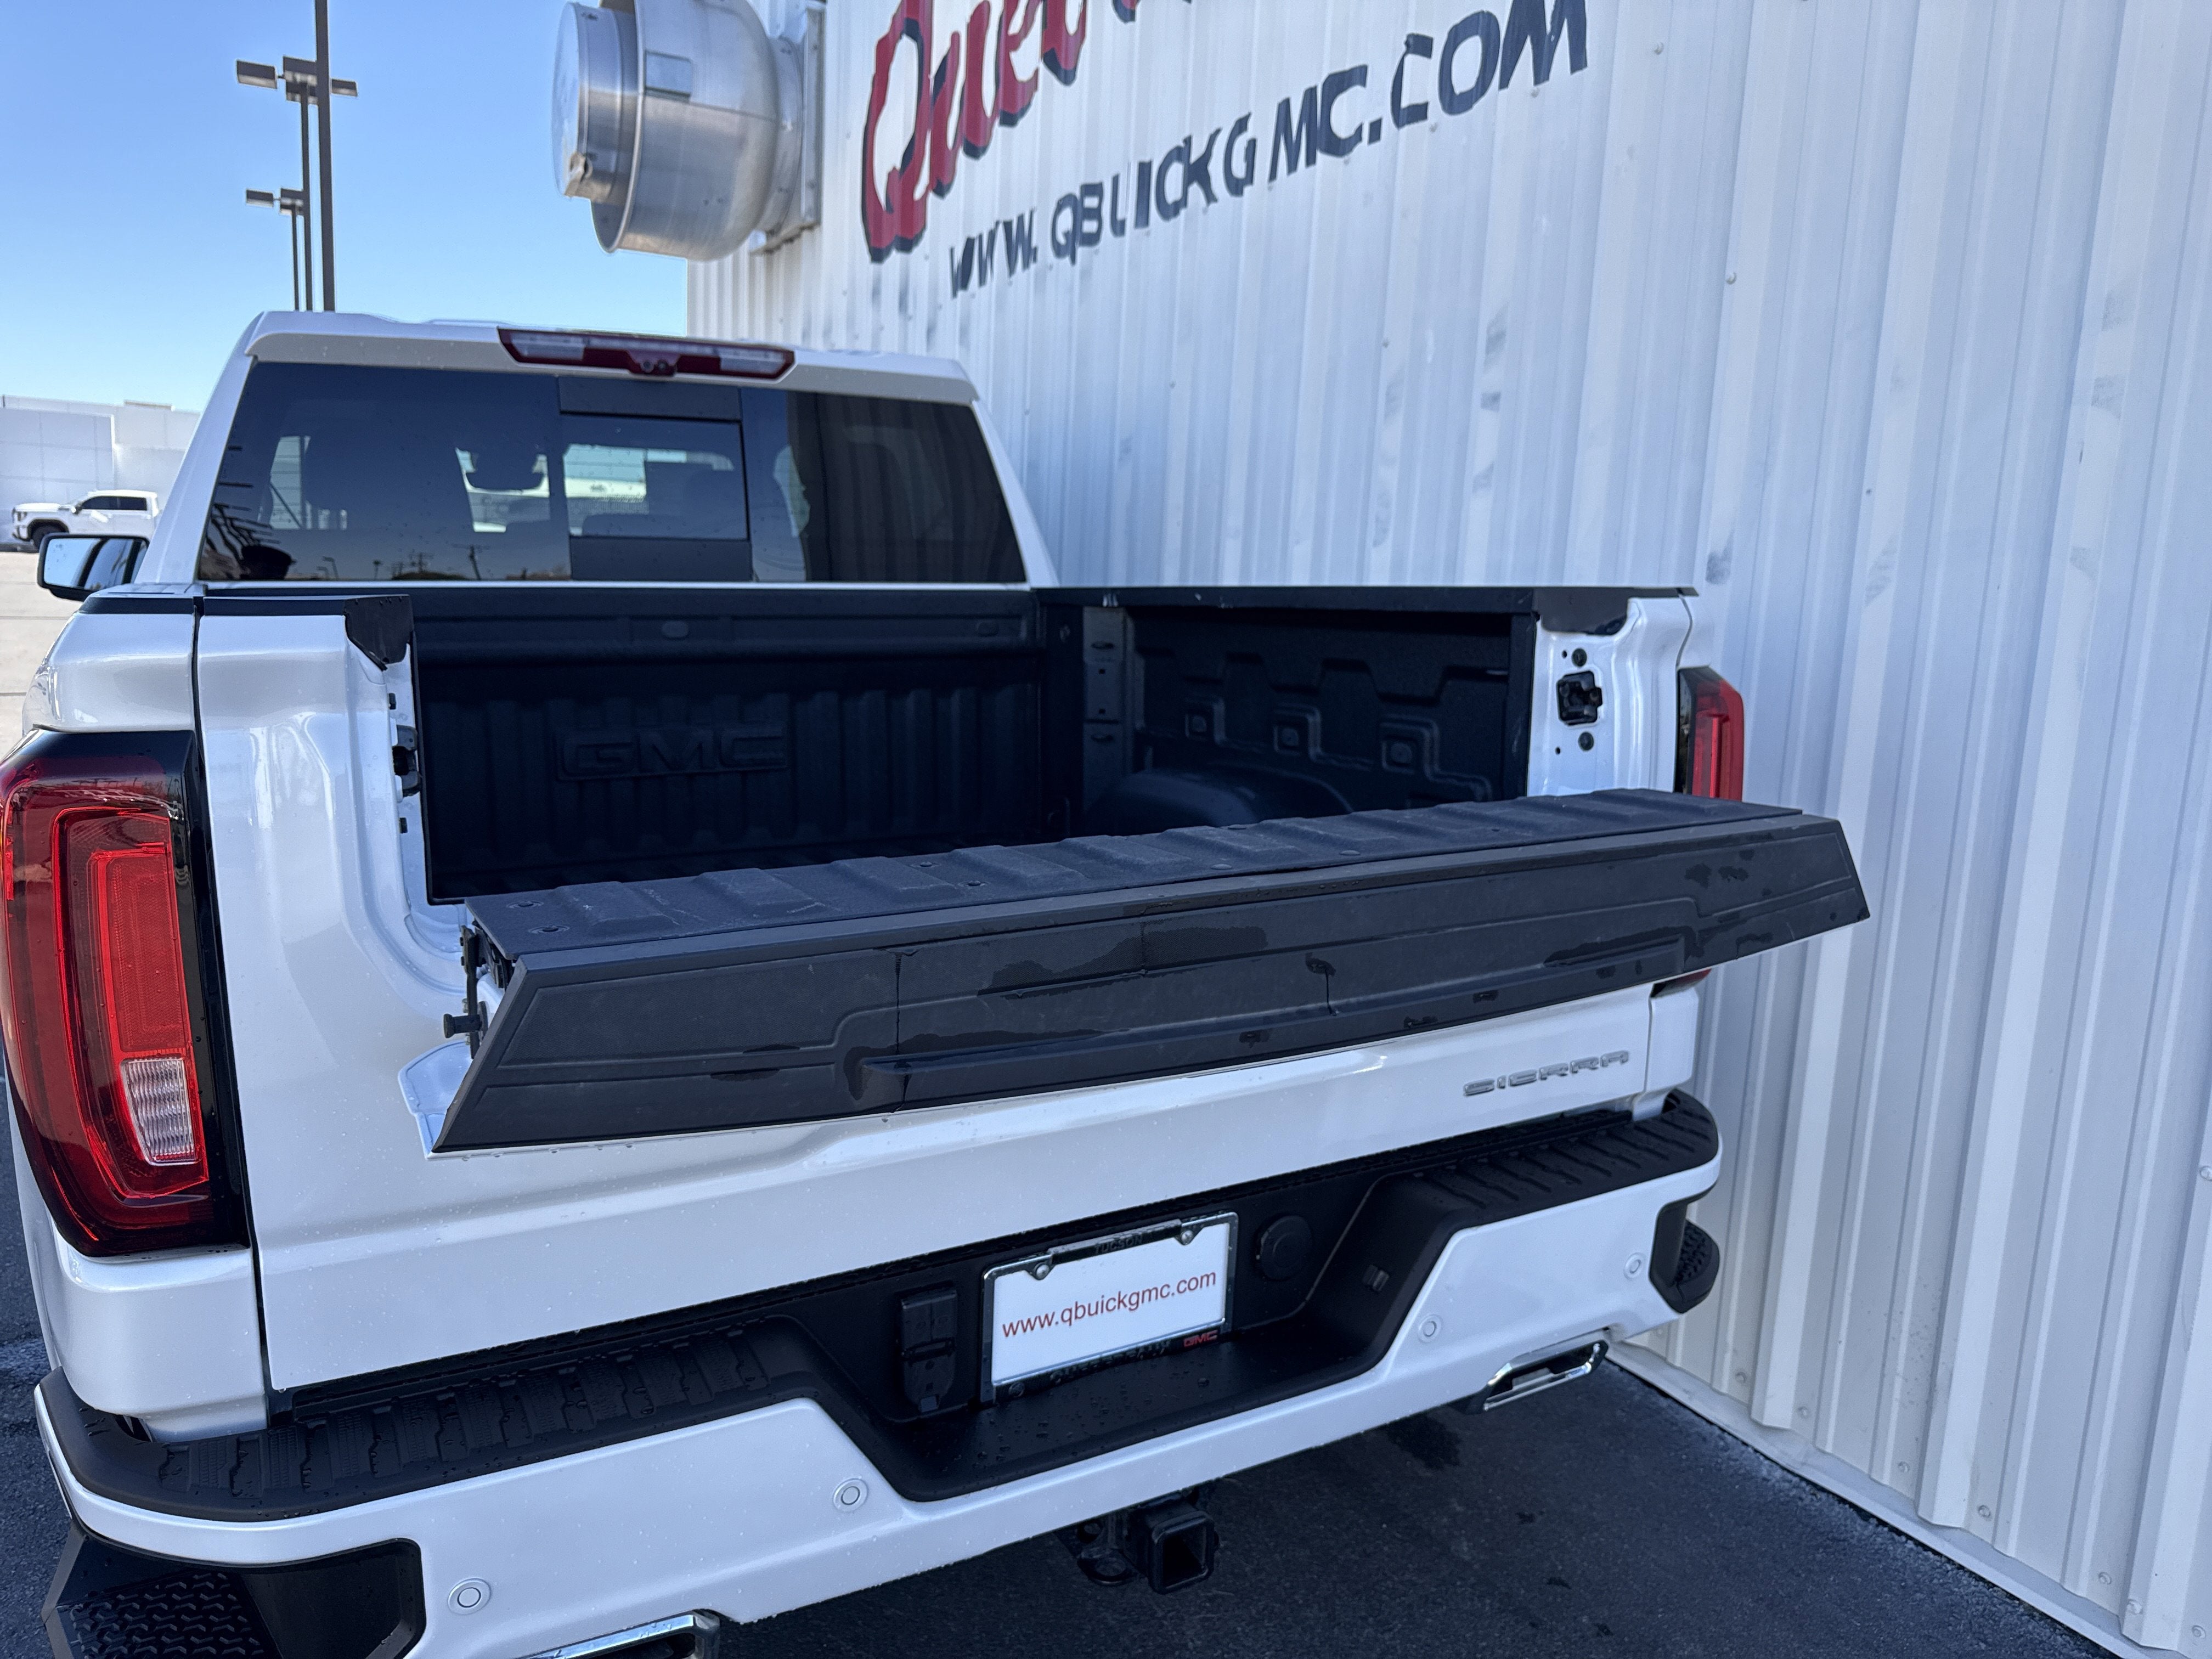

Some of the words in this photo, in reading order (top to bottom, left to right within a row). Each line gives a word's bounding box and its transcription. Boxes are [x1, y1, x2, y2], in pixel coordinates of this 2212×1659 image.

[562, 722, 788, 775] GMC
[1463, 1049, 1629, 1096] SIERRA
[1095, 1234, 1143, 1254] TUCSON
[1002, 1271, 1217, 1339] www.qbuickgmc.com
[1183, 1330, 1218, 1348] GMC
